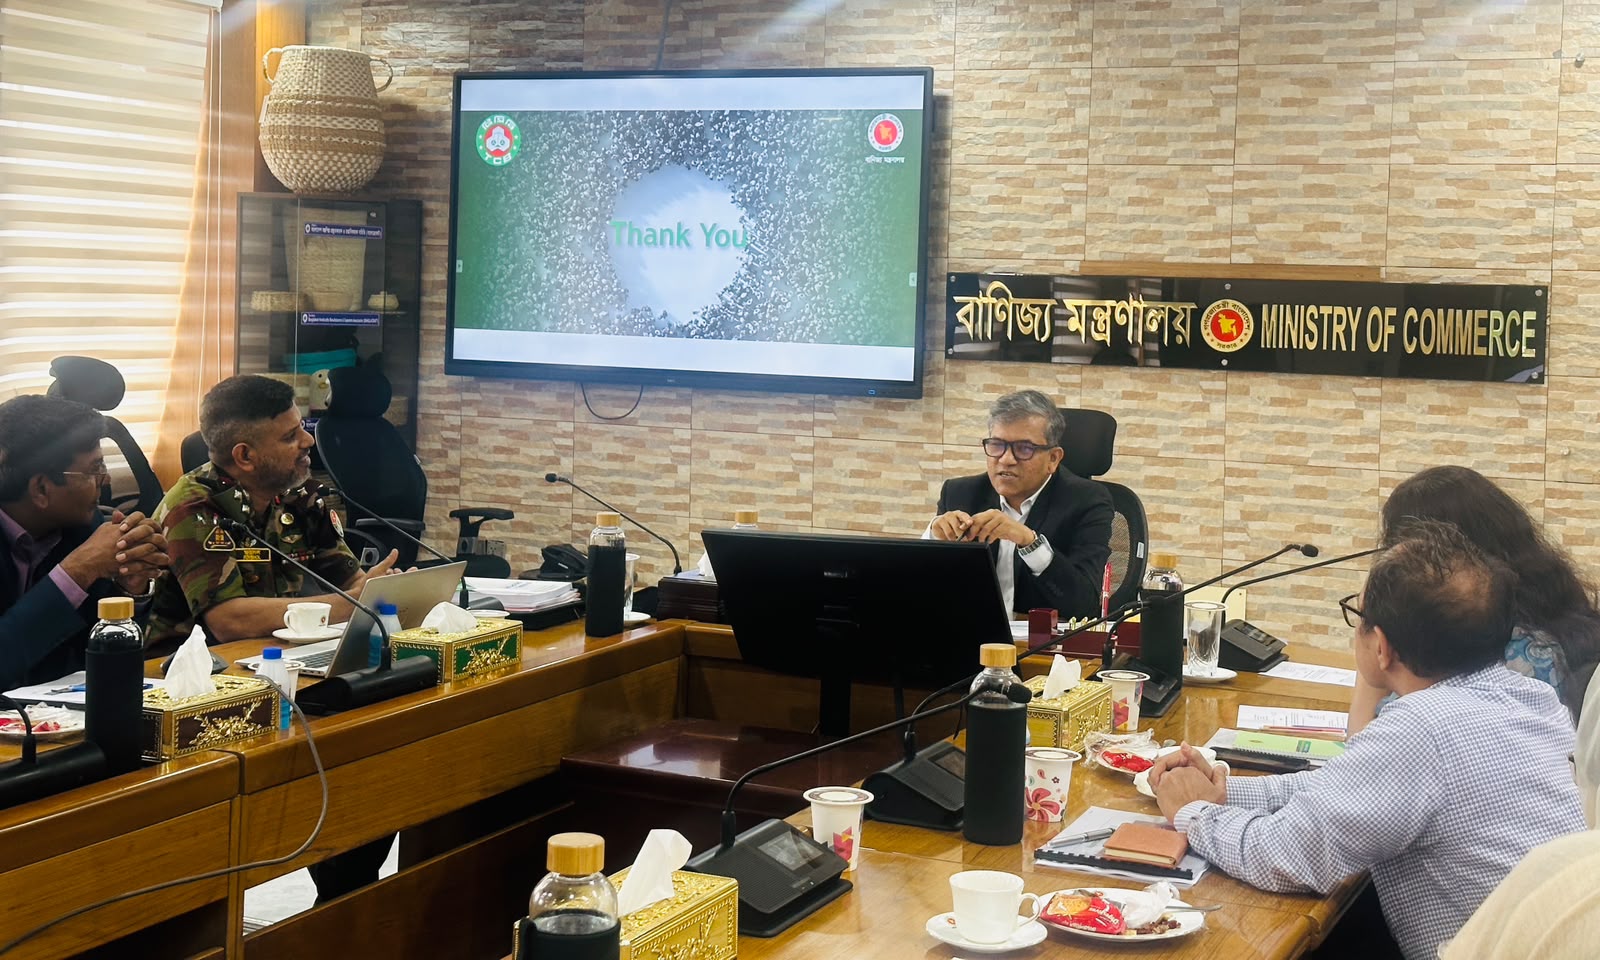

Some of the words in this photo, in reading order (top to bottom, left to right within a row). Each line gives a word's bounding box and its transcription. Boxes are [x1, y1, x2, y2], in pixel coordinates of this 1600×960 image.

[609, 220, 690, 249] Thank
[699, 222, 747, 249] You
[953, 280, 1057, 343] বাণিজ্য
[1063, 294, 1197, 348] মন্ত্রণালয়
[1260, 304, 1362, 352] MINISTRY
[1366, 306, 1398, 353] OF
[1403, 307, 1537, 358] COMMERCE
